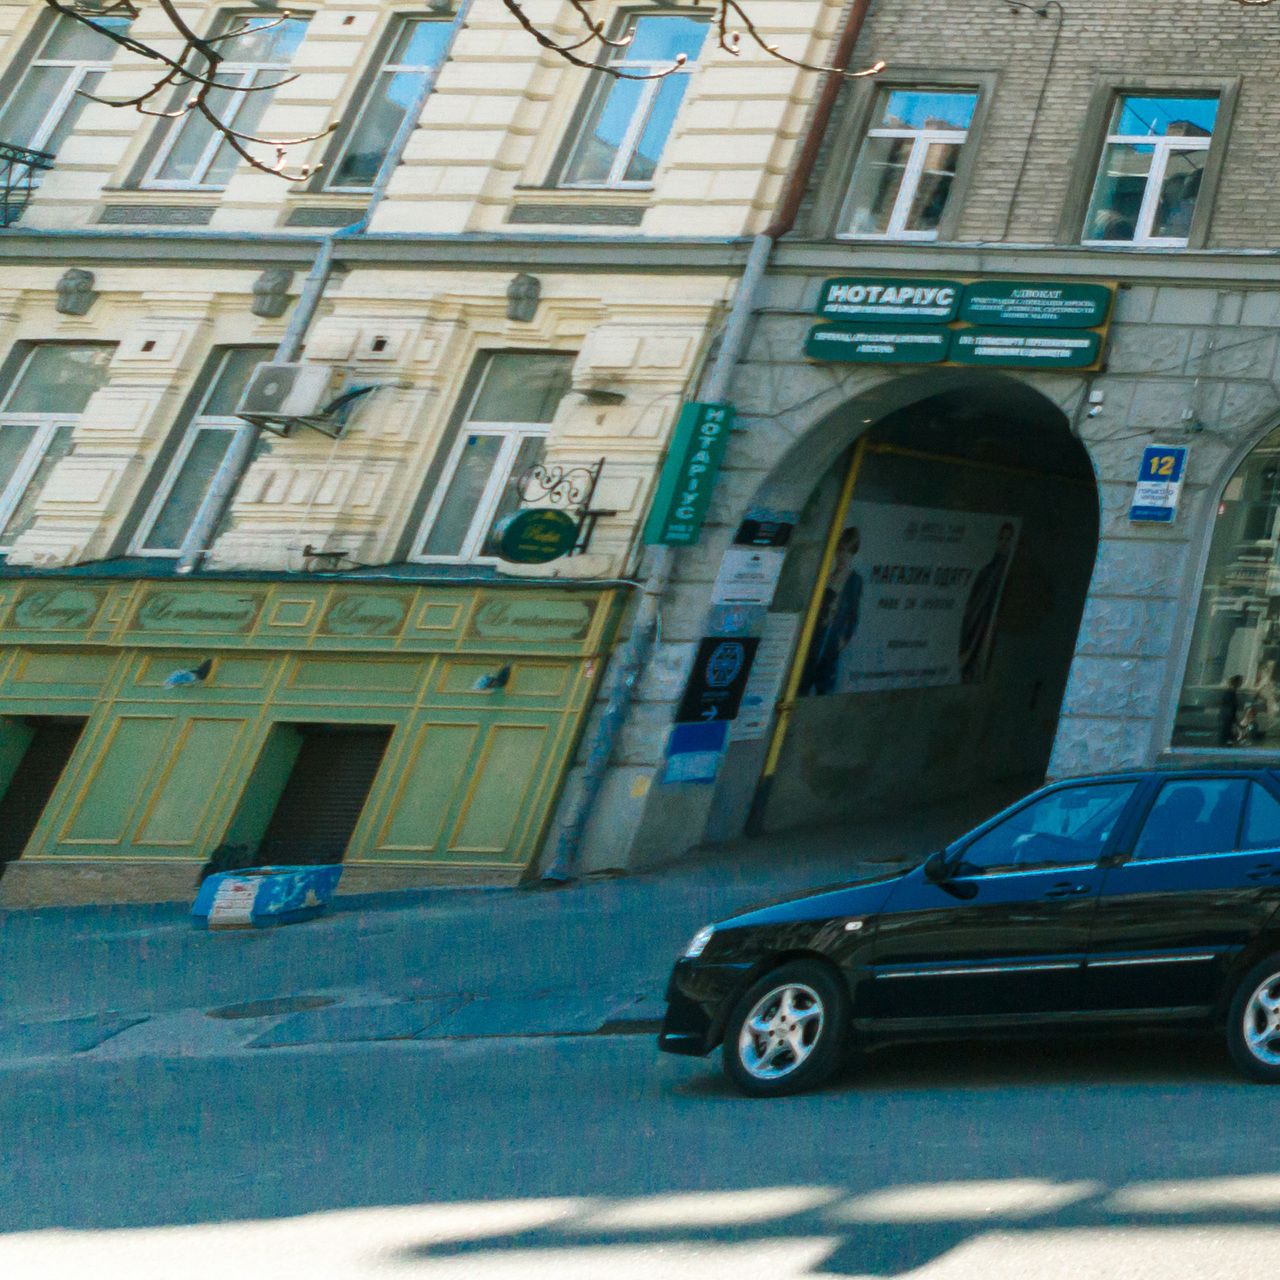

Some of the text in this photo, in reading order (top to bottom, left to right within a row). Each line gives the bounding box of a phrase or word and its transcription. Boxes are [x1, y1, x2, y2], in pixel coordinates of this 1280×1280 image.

[827, 285, 956, 306] НОТАРІУС
[675, 408, 725, 519] НОТАРІУС
[1150, 455, 1175, 475] 12
